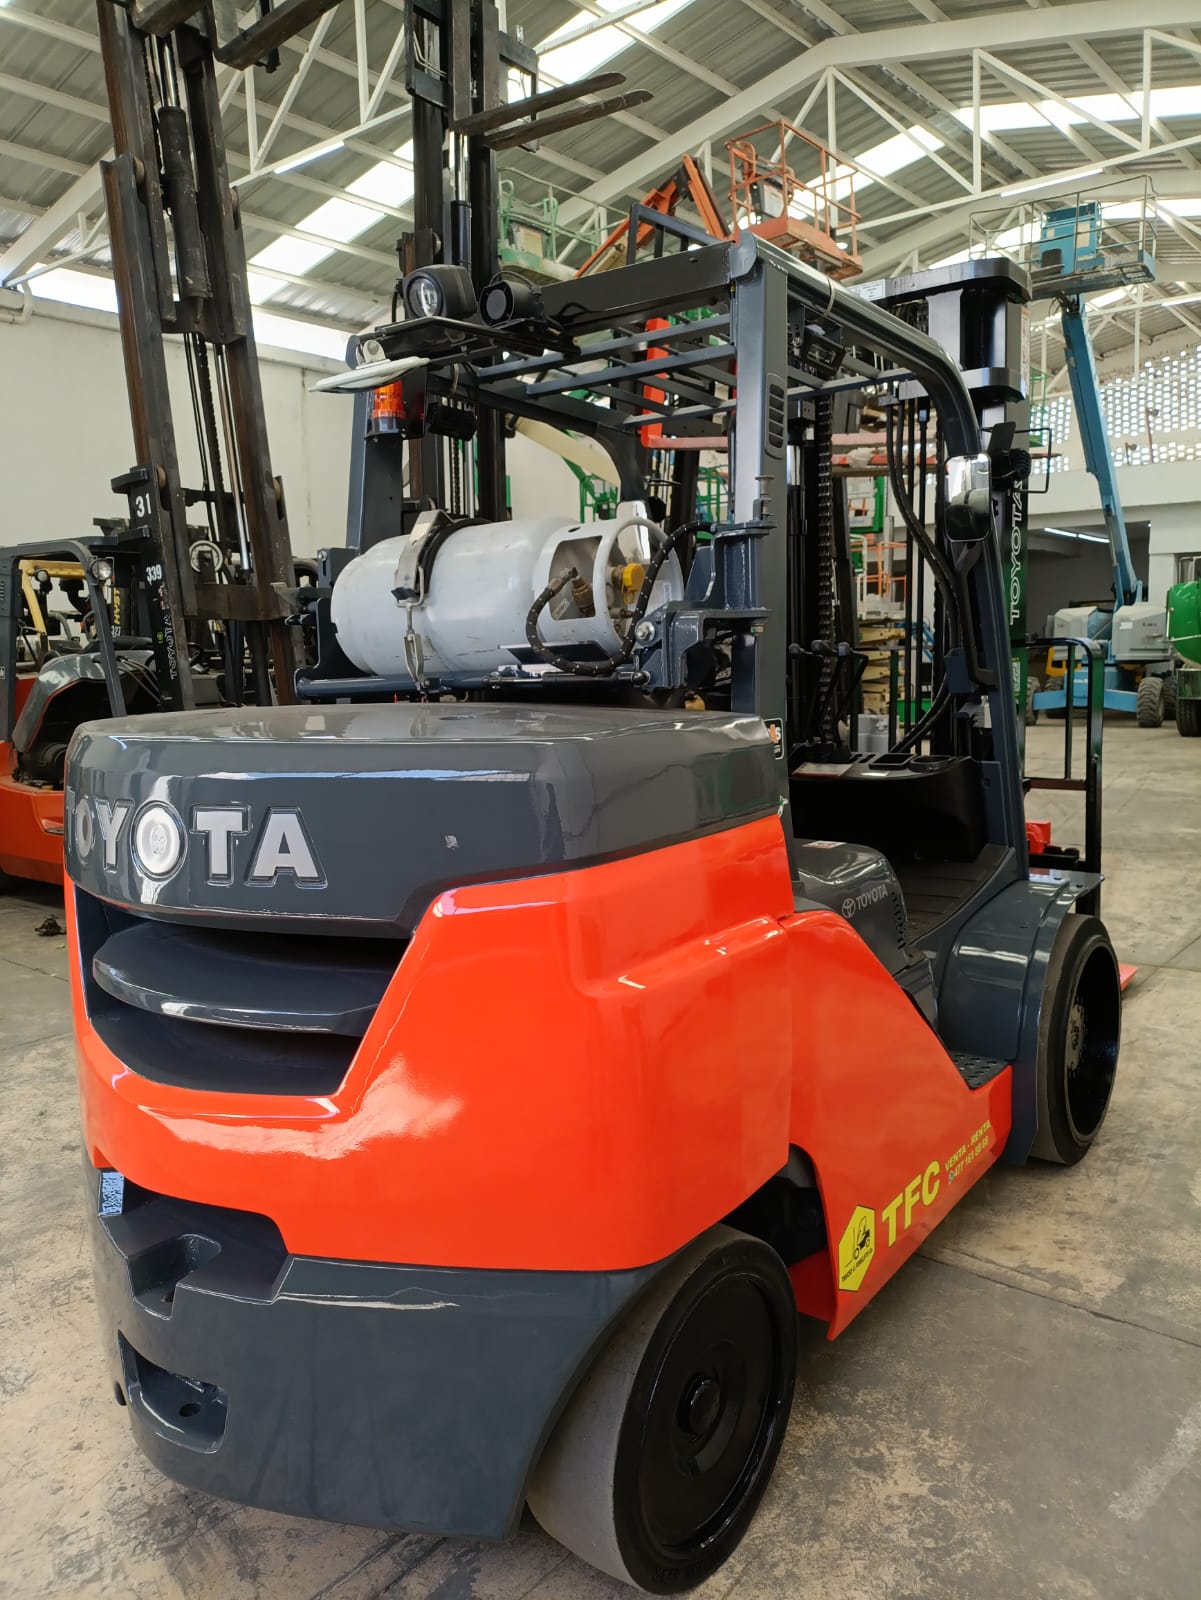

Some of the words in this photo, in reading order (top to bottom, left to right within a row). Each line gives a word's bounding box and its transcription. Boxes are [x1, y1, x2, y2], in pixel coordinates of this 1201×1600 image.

[135, 493, 152, 518] 31
[1010, 480, 1023, 626] TOYOTA
[66, 785, 328, 889] TOYOTA
[855, 884, 888, 910] TOYOTA
[945, 1145, 966, 1171] VENTA
[971, 1119, 990, 1146] RENTA
[882, 1161, 940, 1247] TFC
